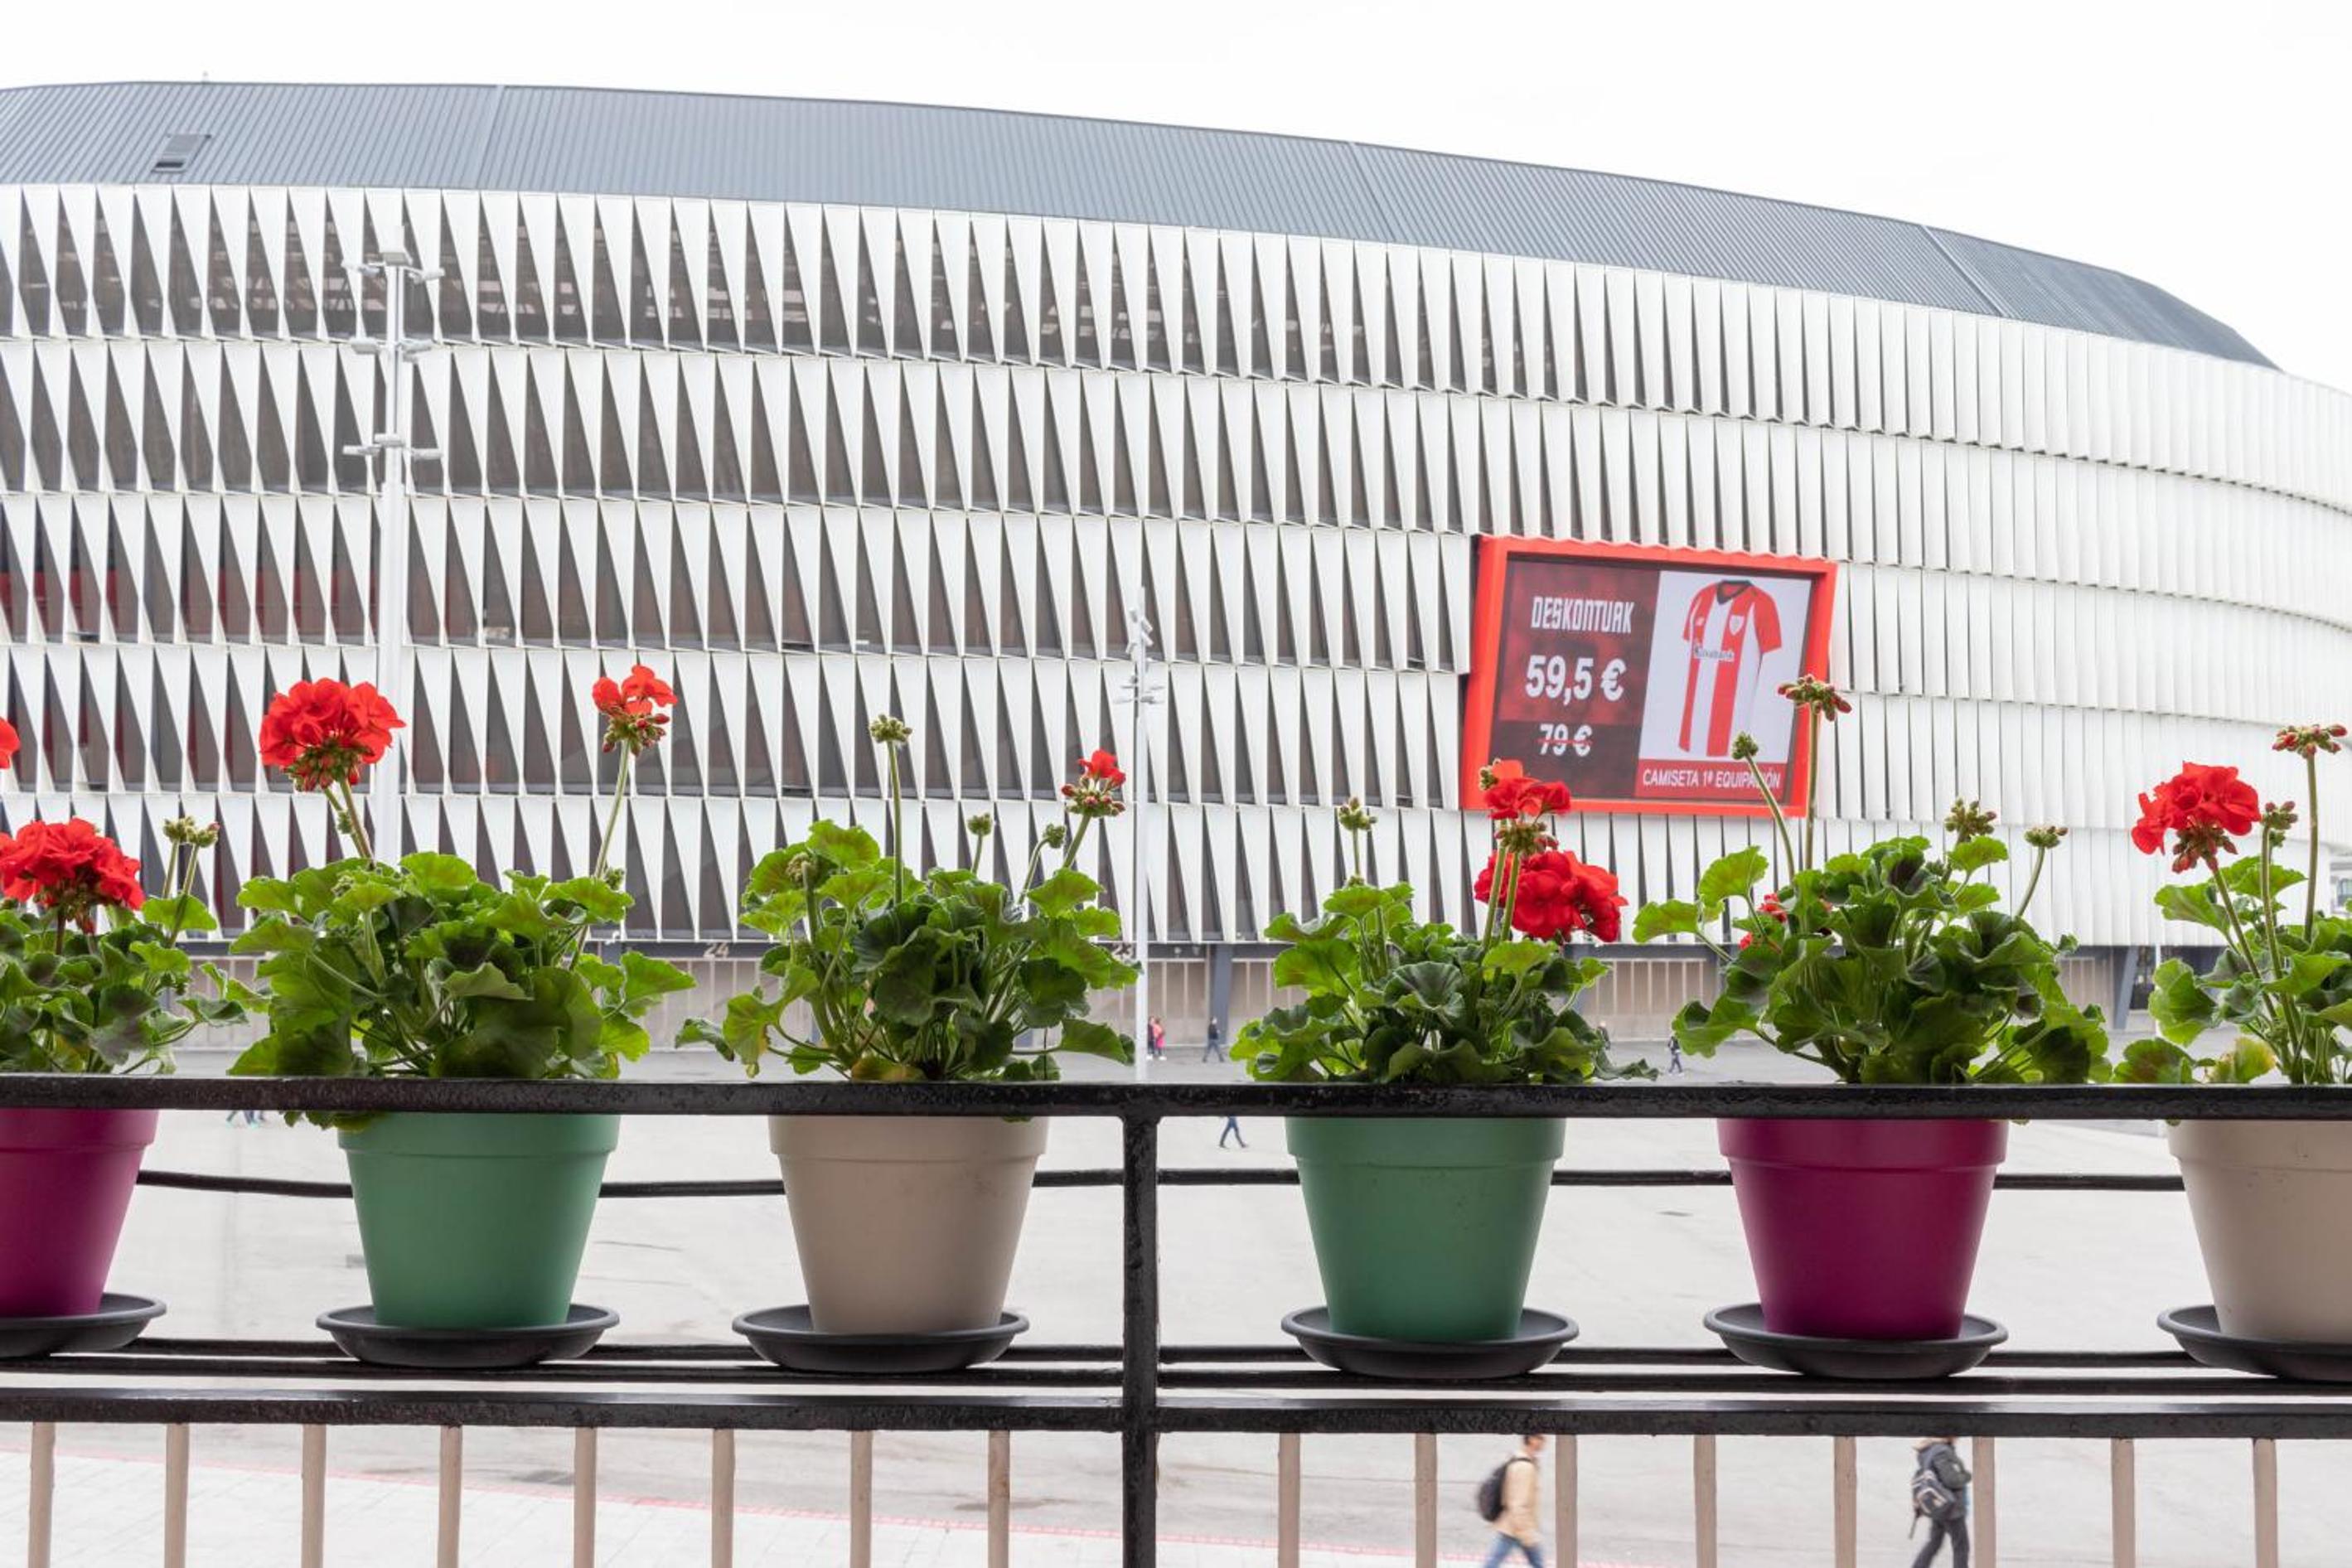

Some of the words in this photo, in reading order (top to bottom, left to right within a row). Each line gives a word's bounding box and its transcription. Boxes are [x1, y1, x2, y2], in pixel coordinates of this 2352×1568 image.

[1531, 596, 1634, 633] DESKONTUAK
[1525, 655, 1594, 705] 59,5
[1600, 658, 1626, 701] €
[1539, 724, 1569, 755] 79
[1573, 724, 1593, 757] €
[1643, 769, 1699, 787] CAMISETA
[1716, 767, 1781, 788] EQUIPAÓN
[704, 942, 729, 959] 24
